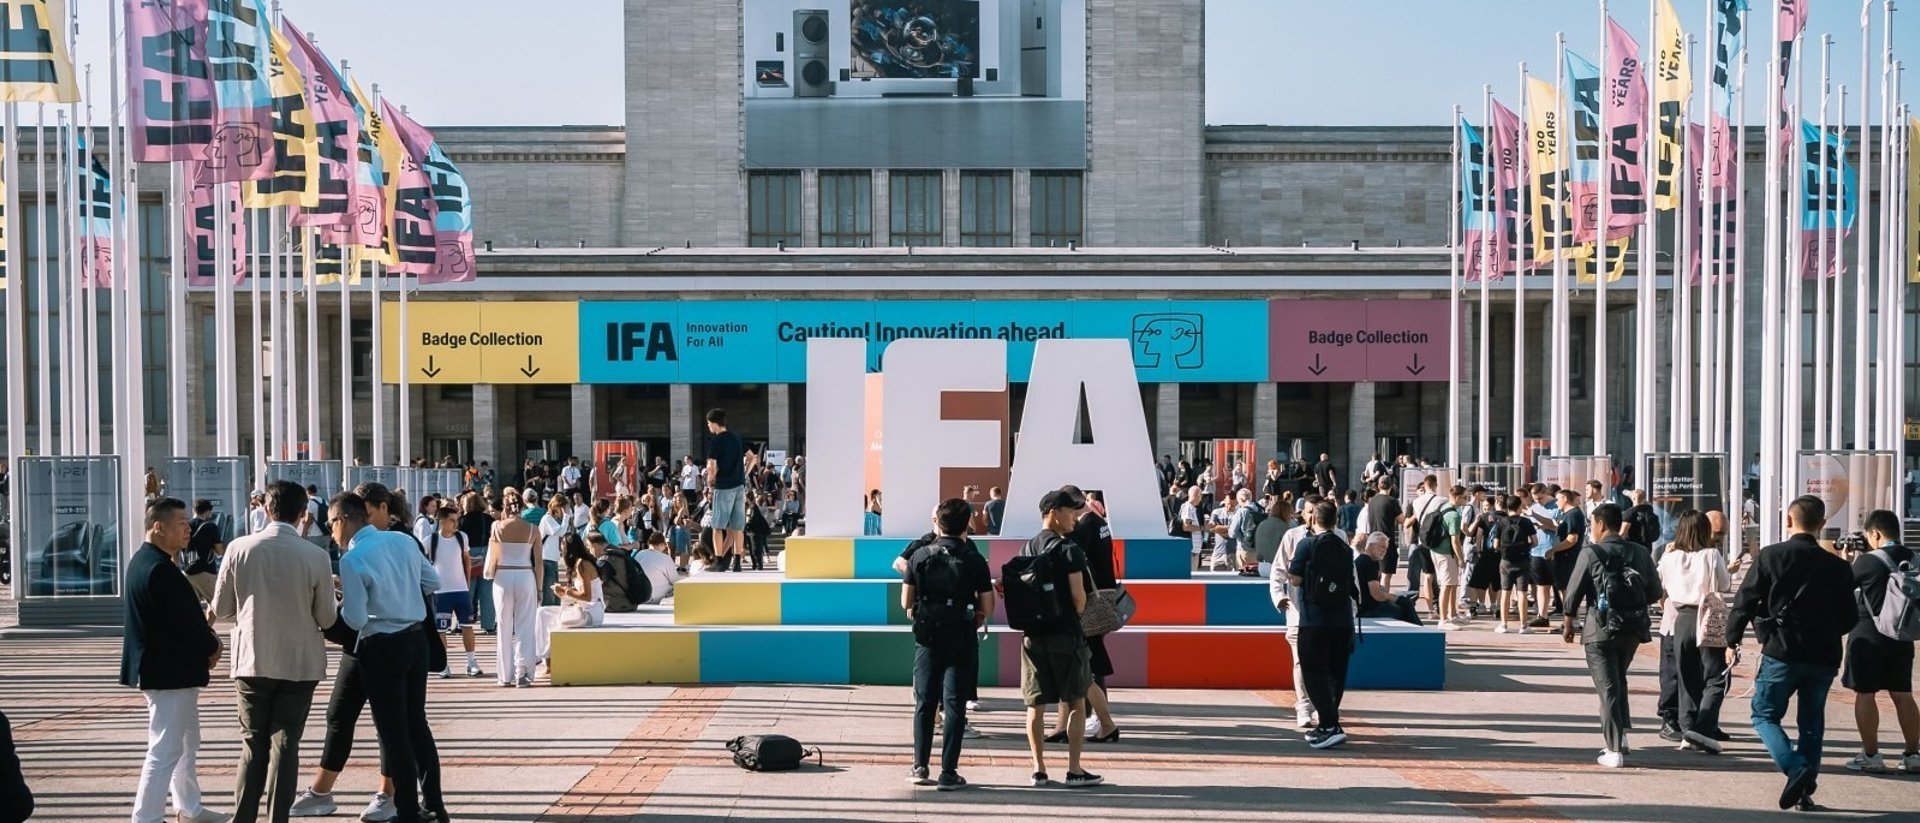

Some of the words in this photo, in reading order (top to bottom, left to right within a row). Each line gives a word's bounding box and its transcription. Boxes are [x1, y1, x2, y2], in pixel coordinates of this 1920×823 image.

[141, 26, 212, 146] IFA
[1616, 57, 1637, 107] YEARS
[1537, 130, 1545, 155] 100
[1546, 111, 1557, 156] YEARS
[300, 120, 348, 215] IFA
[1504, 148, 1512, 170] 100
[1610, 123, 1648, 215] IFA
[395, 187, 436, 264] IFA
[1539, 168, 1572, 250] IFA
[422, 332, 467, 349] Badge
[469, 332, 543, 346] Collection
[606, 322, 678, 361] IFA
[686, 322, 748, 333] Innovation
[686, 337, 705, 347] For
[708, 337, 724, 347] All
[778, 321, 870, 342] Caution!
[876, 321, 992, 342] Innovation
[1309, 330, 1353, 346] Badge
[1356, 330, 1428, 344] Collection
[805, 337, 1168, 539] IFA
